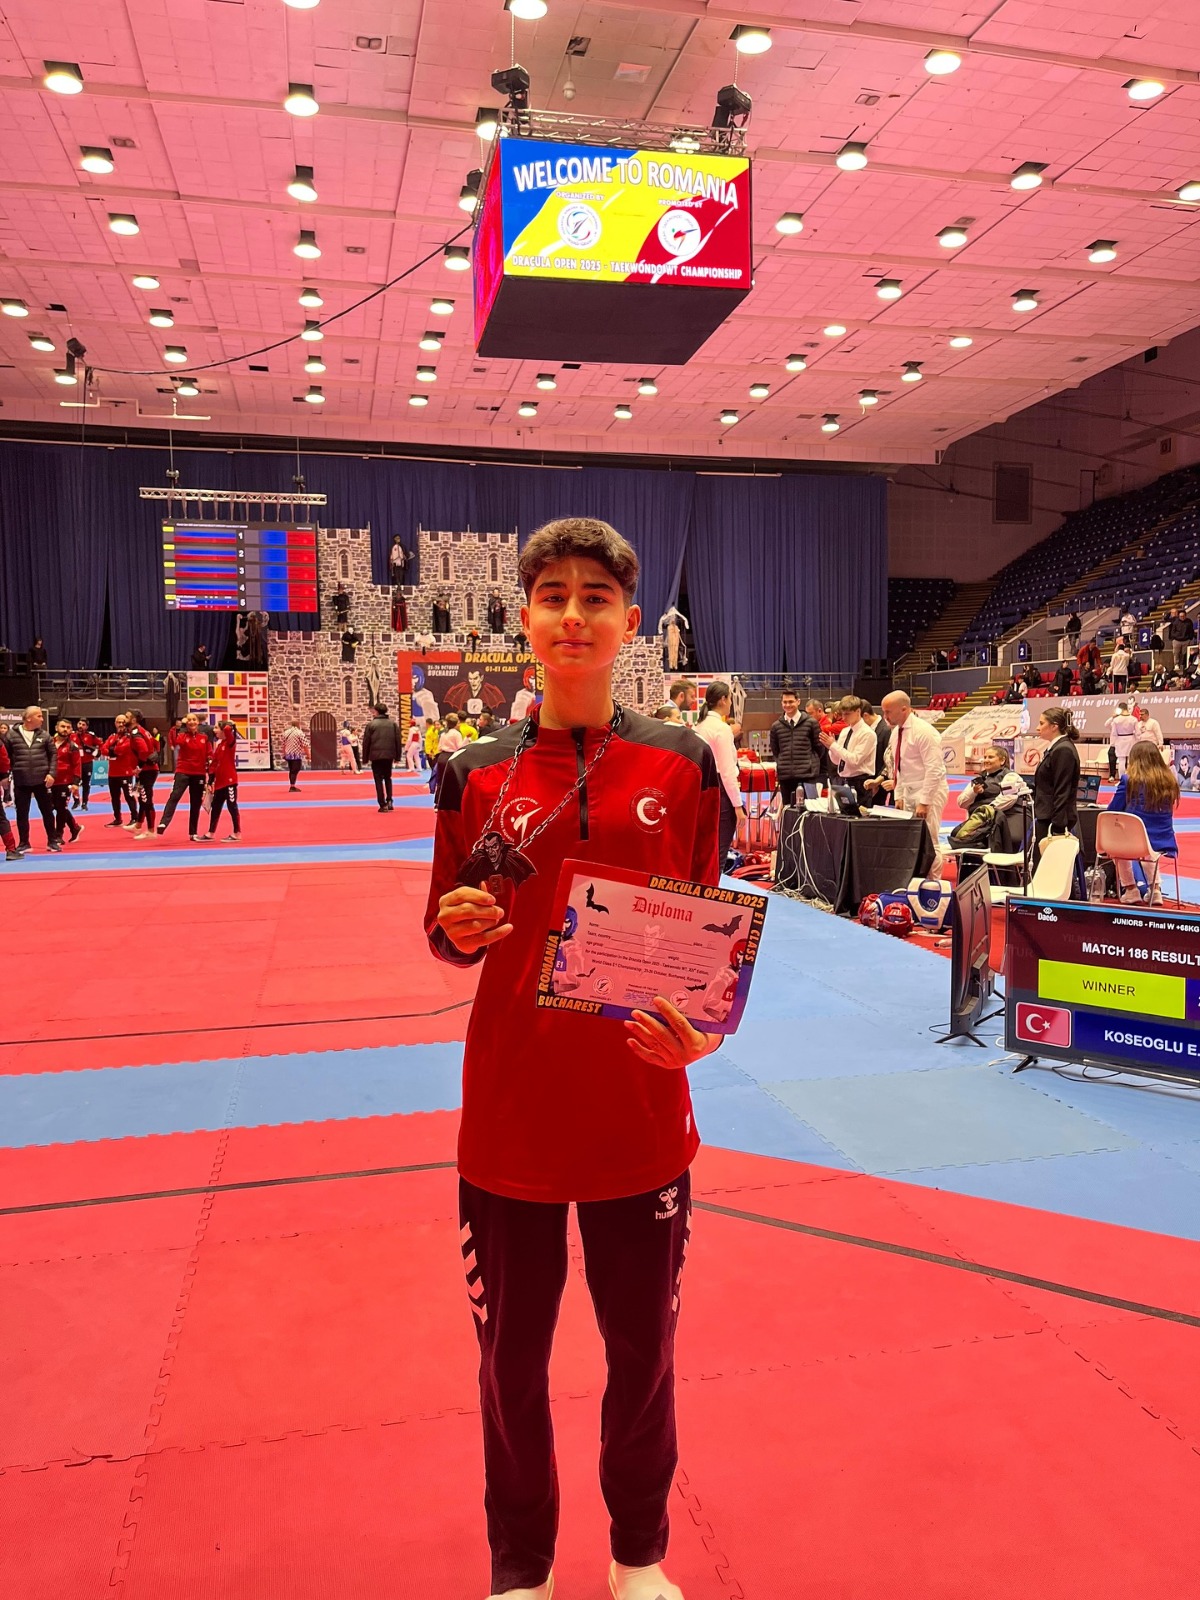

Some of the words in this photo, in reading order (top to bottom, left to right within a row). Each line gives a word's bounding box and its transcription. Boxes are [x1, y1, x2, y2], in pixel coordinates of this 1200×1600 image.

[513, 157, 613, 192] WELCOME
[617, 157, 643, 185] TO
[647, 160, 738, 210] ROMANIA
[556, 191, 595, 201] ORGANIZED
[658, 199, 693, 208] PROMOTED
[512, 255, 551, 269] DRACULA
[554, 258, 577, 269] OPEN
[580, 259, 601, 271] 2025
[610, 261, 664, 275] TAEKWONDO
[680, 265, 743, 280] CHAMPIONSHIP
[238, 532, 243, 540] 1
[238, 549, 244, 558] 2
[239, 567, 245, 575] 3
[239, 584, 245, 592] 4
[1142, 632, 1148, 642] 2
[981, 652, 986, 661] 1
[1019, 647, 1025, 656] 2
[464, 652, 513, 664] DRACULA
[516, 652, 541, 663] OPE
[1061, 698, 1082, 708] Fight
[1082, 697, 1094, 706] for
[1097, 697, 1119, 708] glory
[1141, 696, 1149, 704] in
[1150, 695, 1163, 704] the
[1164, 695, 1187, 703] heart
[1188, 694, 1199, 702] of
[649, 877, 702, 896] DRACULA
[703, 887, 735, 903] OPEN
[736, 894, 766, 908] 2025
[632, 896, 693, 922] Diploma
[1037, 912, 1058, 922] Daedo
[1112, 917, 1143, 927] JUNIORS
[1148, 921, 1166, 930] Final
[744, 929, 760, 962] CLASS
[1082, 942, 1125, 957] MATCH
[1127, 947, 1149, 960] 186
[538, 935, 560, 993] ROMANIA
[555, 960, 564, 969] E1
[1082, 979, 1136, 997] WINNER
[537, 995, 602, 1014] BUCHAREST
[1104, 1029, 1183, 1054] KOSEOGLU
[1187, 1043, 1200, 1057] E.
